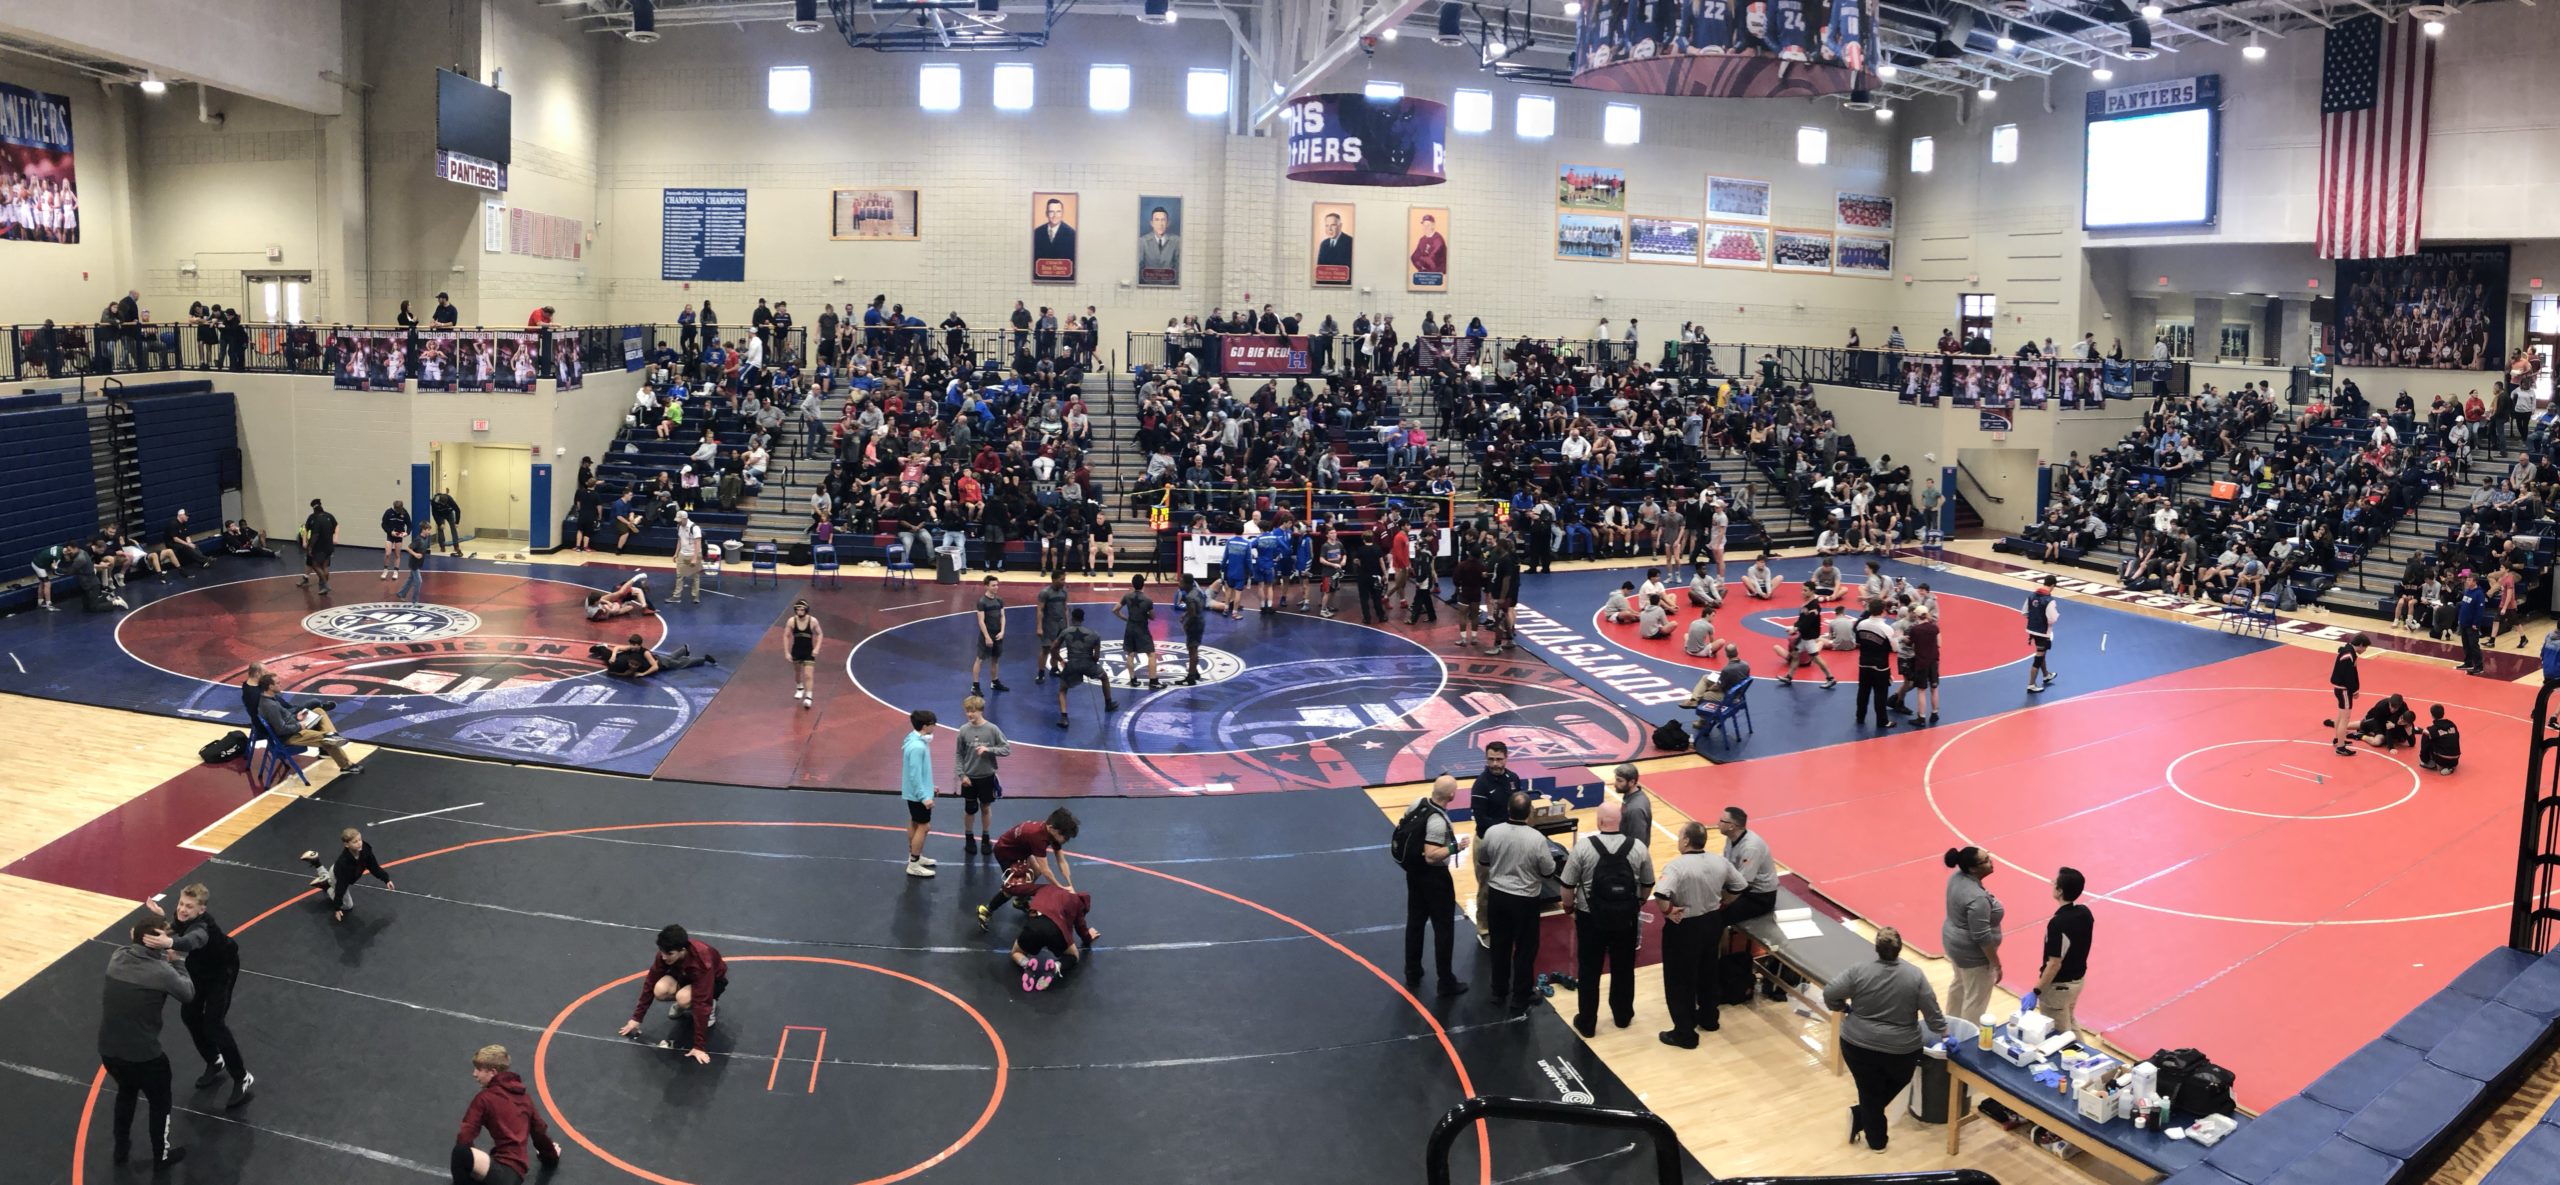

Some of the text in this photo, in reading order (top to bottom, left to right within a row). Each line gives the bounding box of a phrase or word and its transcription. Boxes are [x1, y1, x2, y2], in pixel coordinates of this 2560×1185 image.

[1703, 1, 1726, 20] 22
[1784, 11, 1806, 31] 24
[450, 160, 497, 188] PANTHERS
[665, 196, 746, 205] CHAMPIONS CHAMPIONS
[1230, 346, 1291, 358] GO BIG RED!
[1288, 350, 1307, 369] H
[318, 628, 412, 641] ALABAMA
[329, 641, 571, 661] MADISON
[1527, 779, 1533, 791] 1
[1576, 785, 1584, 798] 2
